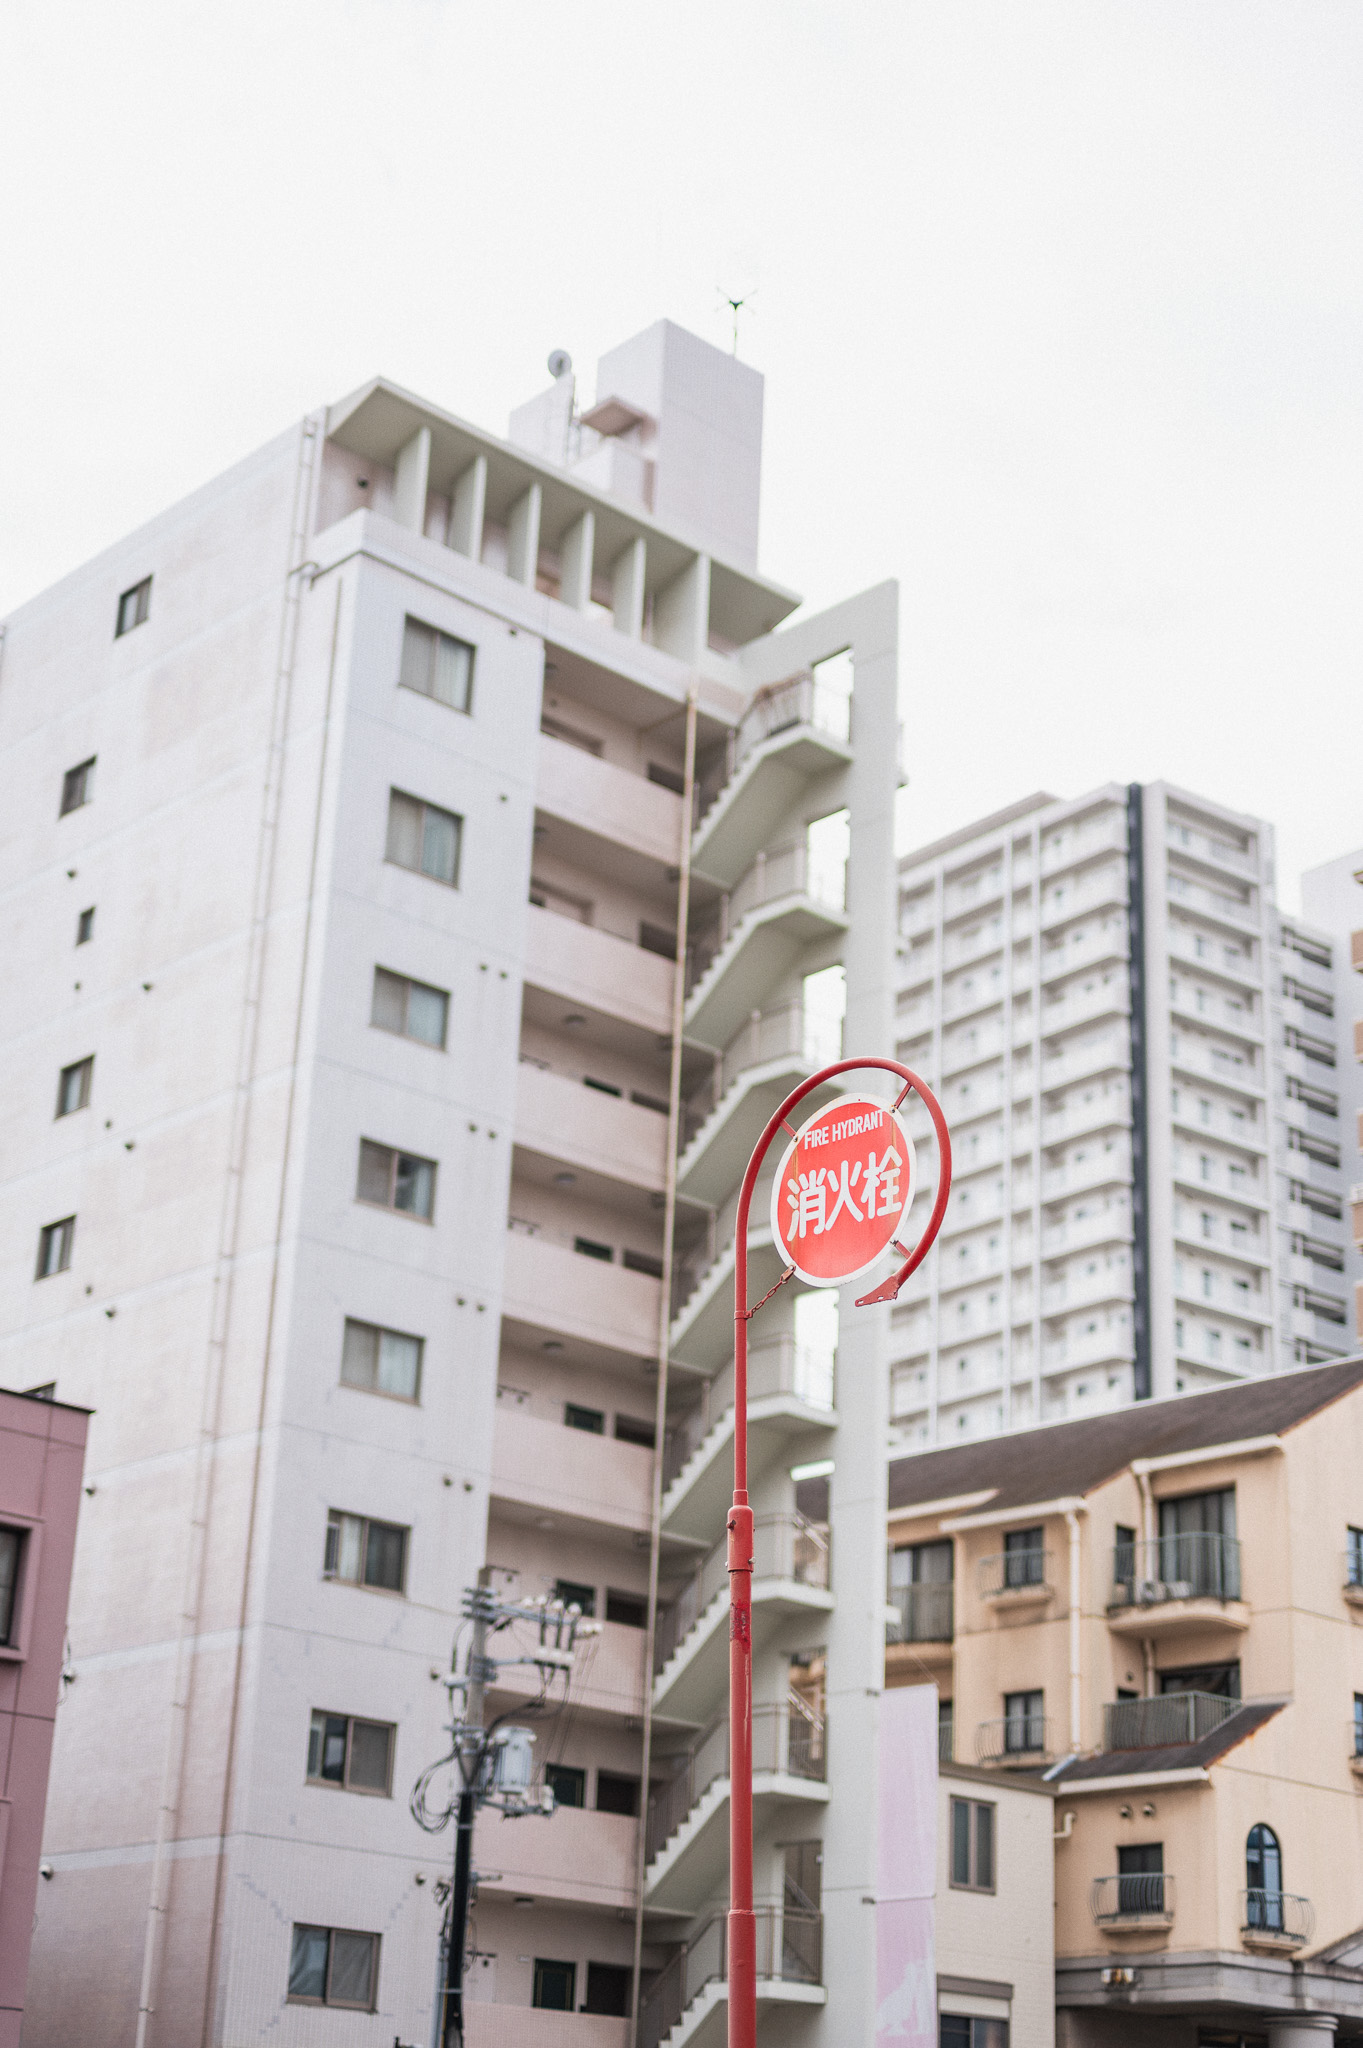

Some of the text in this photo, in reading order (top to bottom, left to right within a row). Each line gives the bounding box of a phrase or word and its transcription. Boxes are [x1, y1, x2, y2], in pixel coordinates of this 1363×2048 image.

[804, 1109, 885, 1149] FIRE HYDRANT
[787, 1145, 903, 1241] 消火栓
